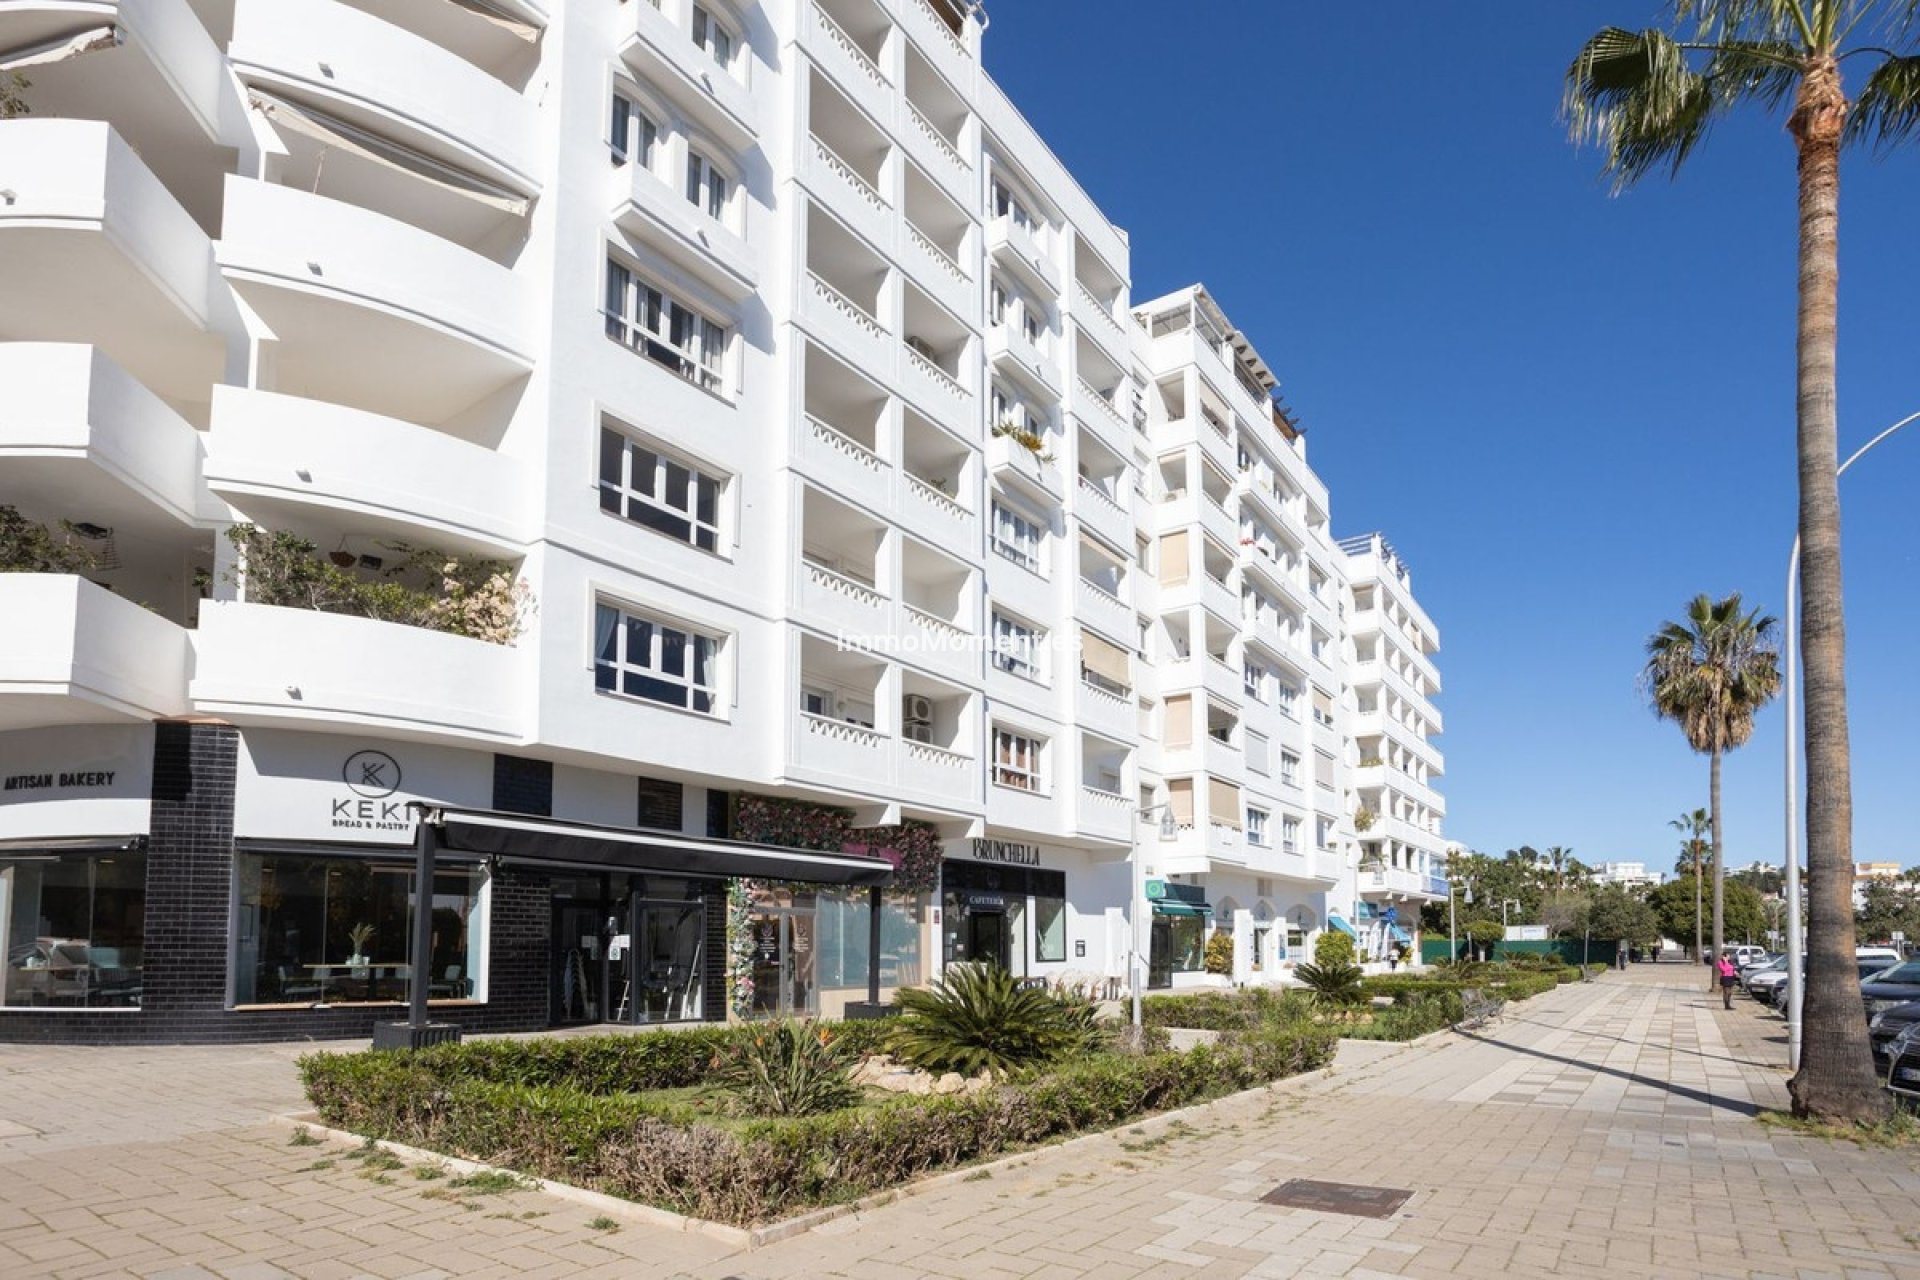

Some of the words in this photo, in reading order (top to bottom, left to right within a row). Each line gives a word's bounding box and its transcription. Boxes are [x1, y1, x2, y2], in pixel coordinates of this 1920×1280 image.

[4, 773, 53, 790] ARTISAN
[59, 771, 115, 787] BAKERY
[332, 819, 362, 828] BREAD
[366, 821, 372, 829] &
[376, 822, 409, 831] PASTRY
[973, 838, 1041, 866] BRUNCHELLA
